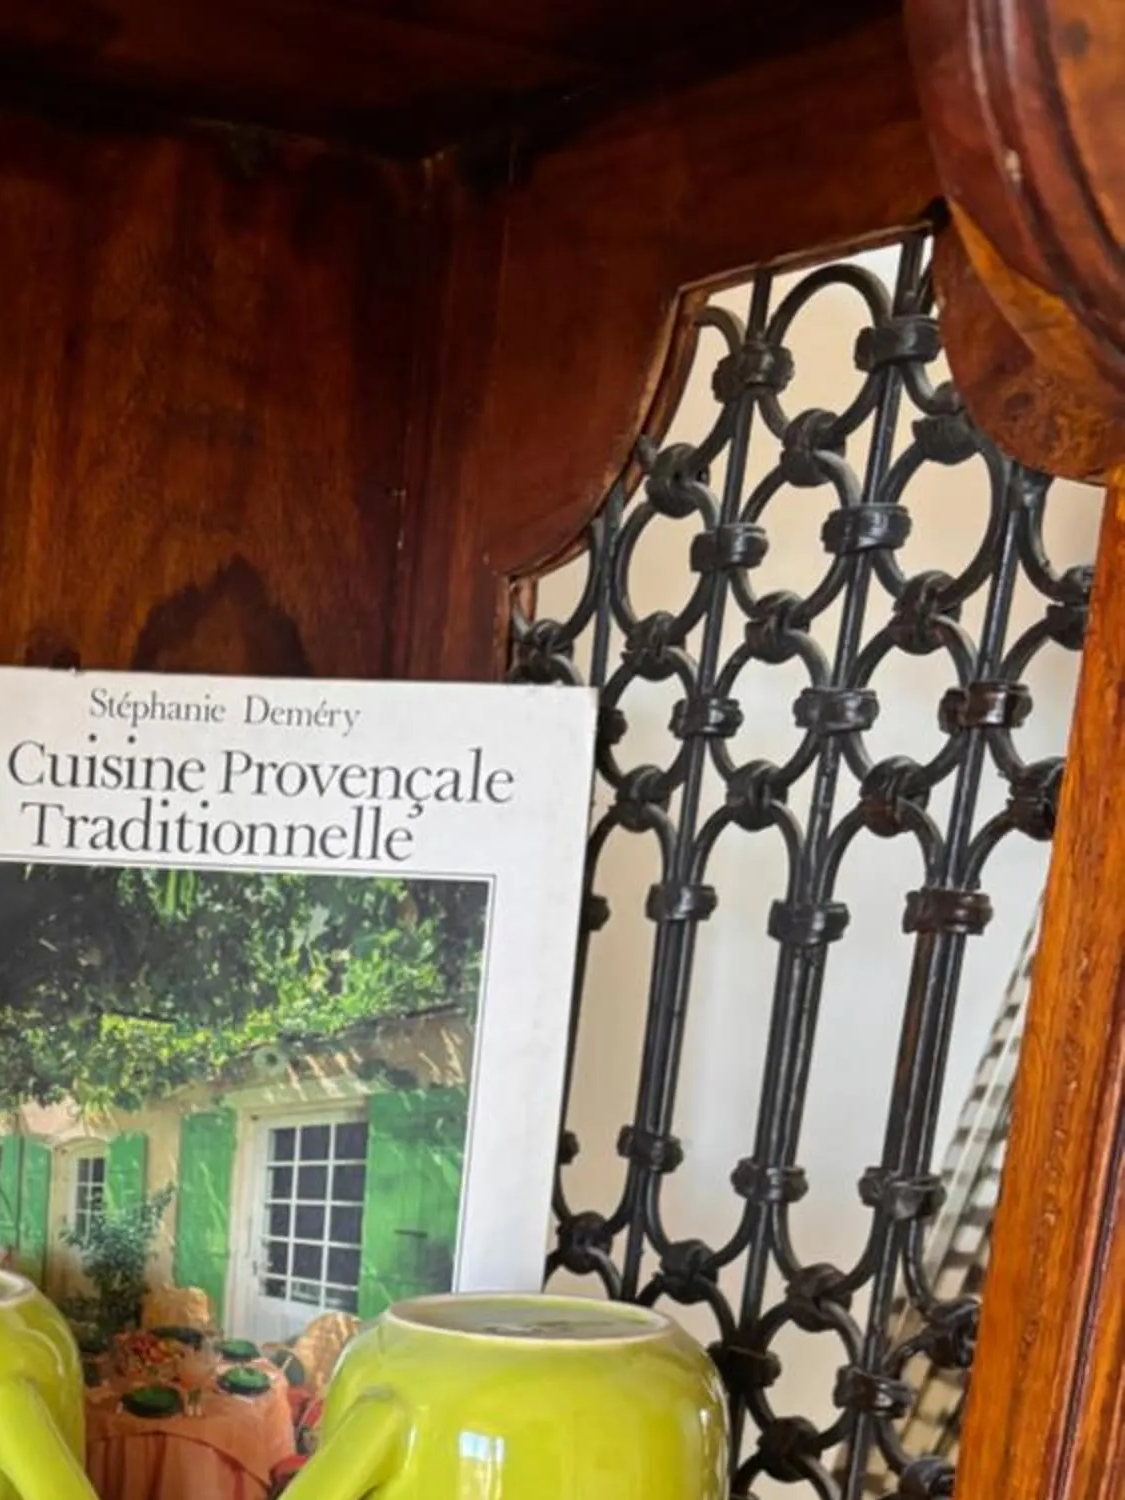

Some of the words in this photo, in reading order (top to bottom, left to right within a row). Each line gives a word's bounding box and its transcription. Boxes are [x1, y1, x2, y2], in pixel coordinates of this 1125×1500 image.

[89, 687, 226, 728] Stéphanie
[243, 694, 362, 737] Deméry
[7, 733, 207, 793] Cuisine
[218, 747, 515, 819] Provençale
[21, 796, 414, 862] Traditionnelle
